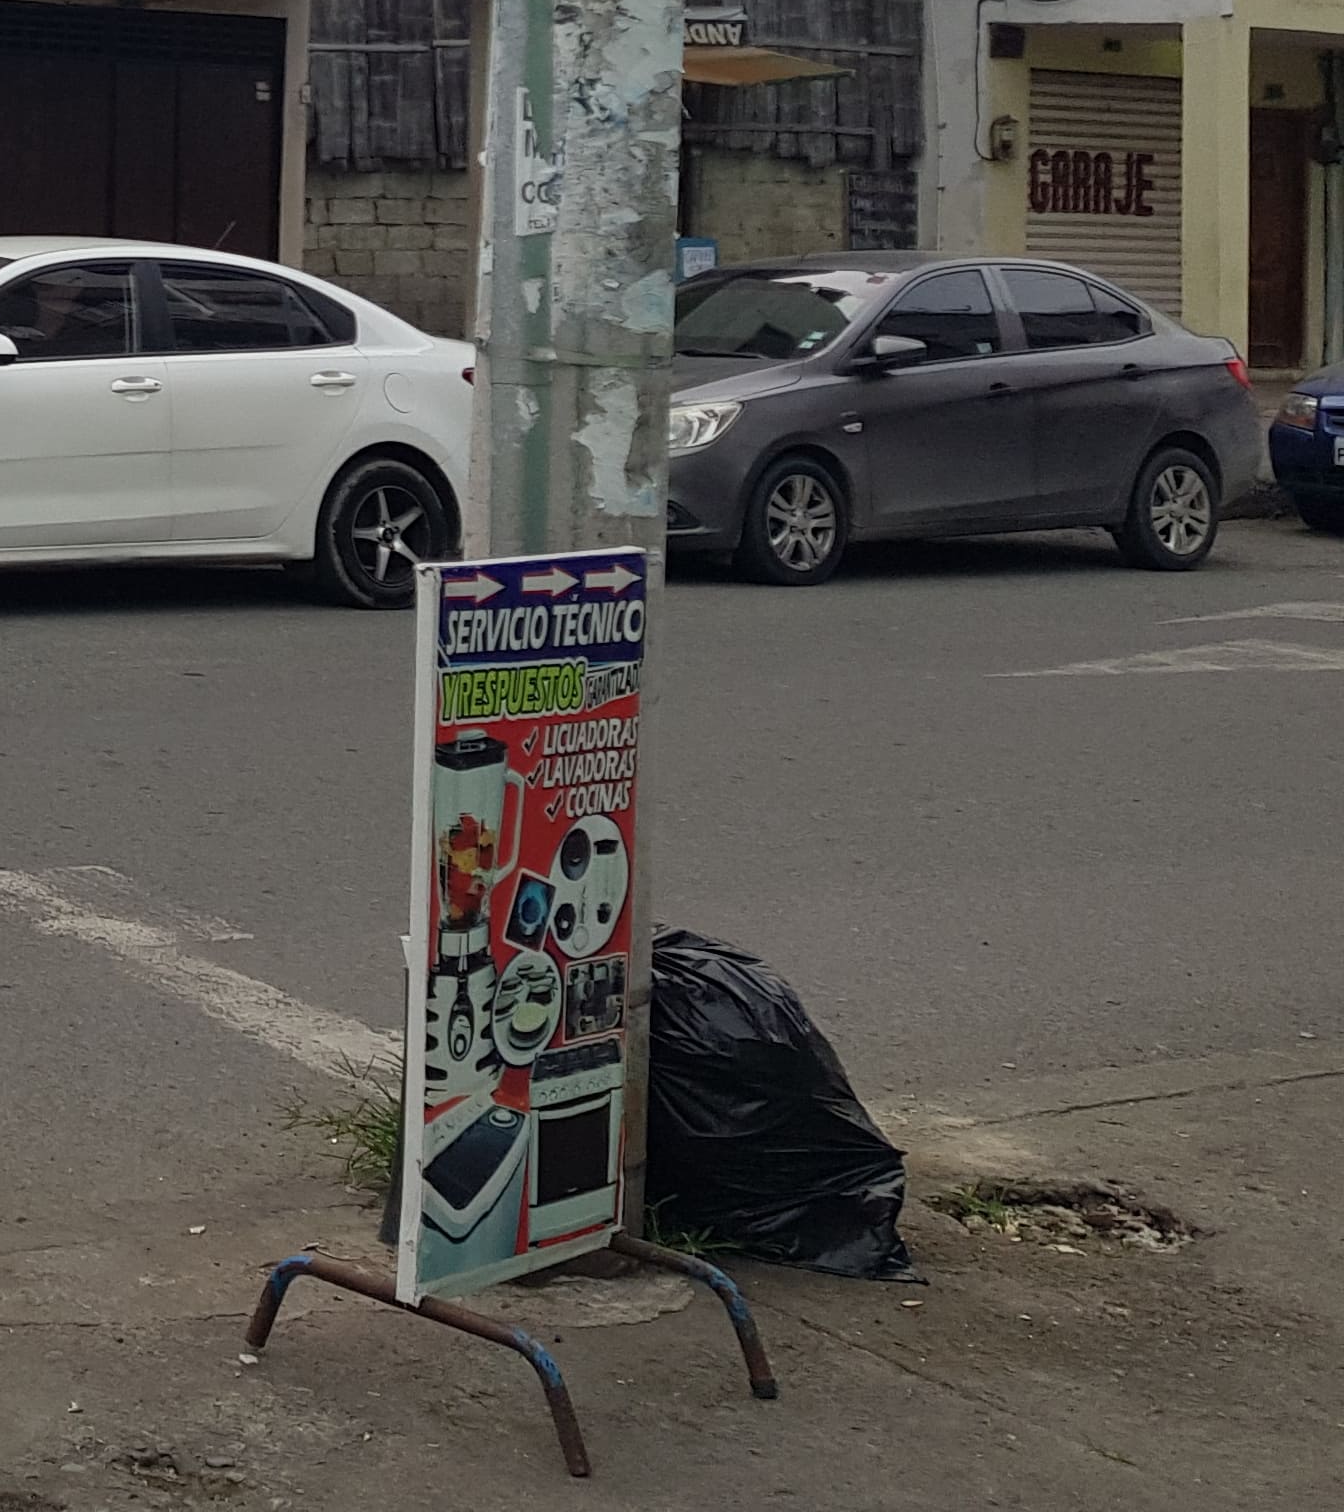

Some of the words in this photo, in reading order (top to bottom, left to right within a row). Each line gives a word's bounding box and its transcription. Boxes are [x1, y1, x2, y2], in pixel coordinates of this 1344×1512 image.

[1030, 149, 1154, 217] GARAJE
[446, 605, 549, 656] SERVICIO
[552, 592, 645, 647] TÉCNICO
[543, 715, 639, 756] LICUADORAS
[543, 748, 637, 788] LAVADORAS
[565, 780, 632, 818] COCINAS
